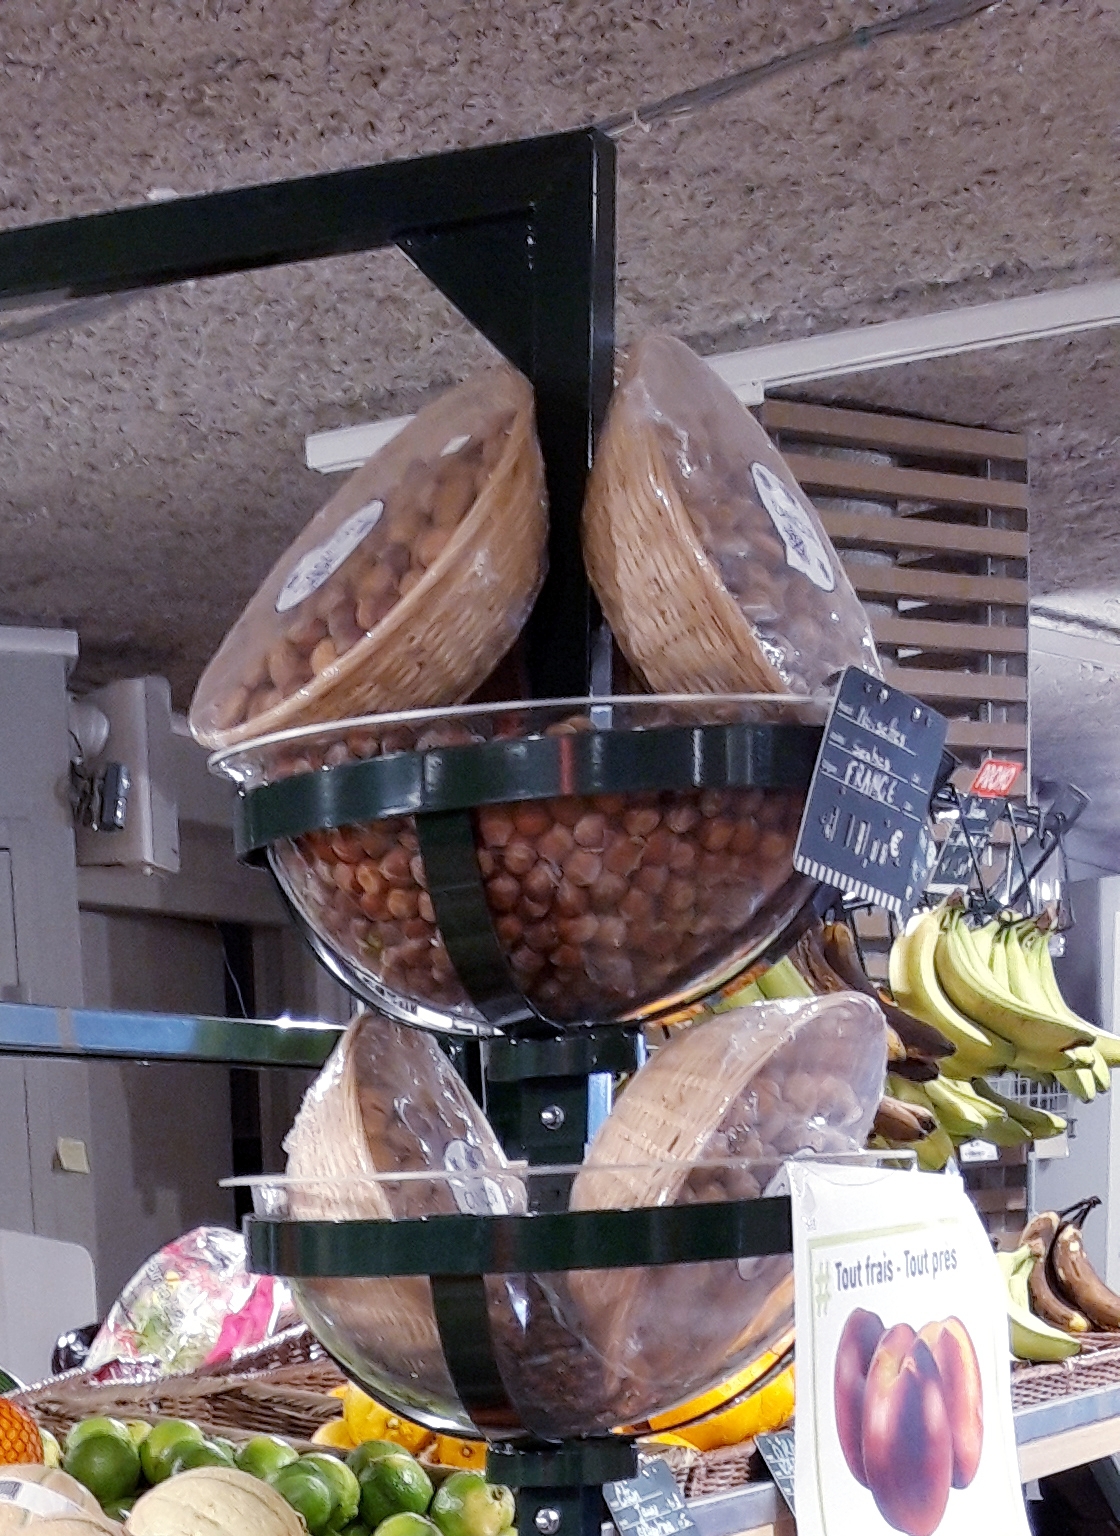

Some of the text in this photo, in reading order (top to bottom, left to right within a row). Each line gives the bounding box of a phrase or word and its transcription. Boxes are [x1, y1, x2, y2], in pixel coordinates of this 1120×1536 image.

[835, 1261, 863, 1291] Tout
[865, 1250, 893, 1286] frais
[904, 1249, 929, 1278] Tout
